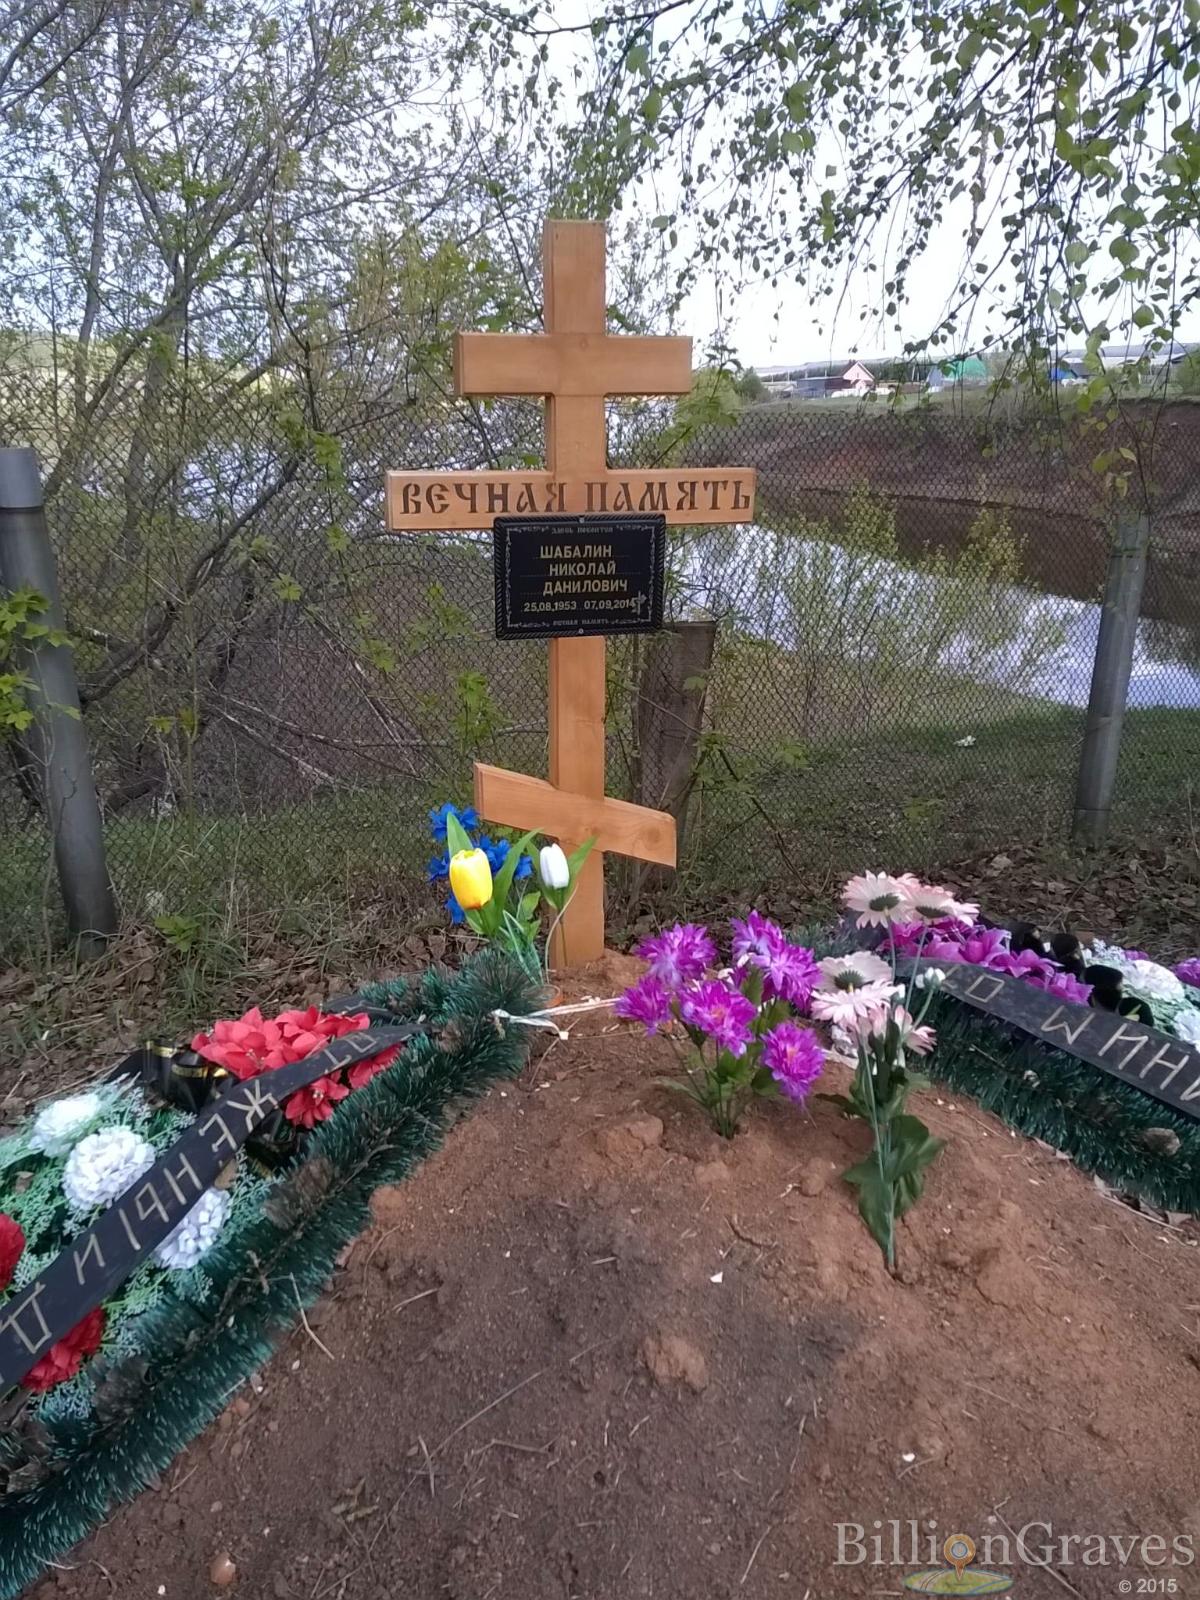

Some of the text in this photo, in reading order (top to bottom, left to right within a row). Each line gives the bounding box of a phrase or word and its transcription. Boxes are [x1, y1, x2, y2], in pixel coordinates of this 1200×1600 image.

[401, 480, 751, 514] ВЕЧНАЯ ПАМЯТЬ
[540, 545, 612, 559] ШАБАЛИН
[549, 560, 616, 576] НИКОЛАЙ
[543, 579, 628, 596] ДАНИЛОВИЧ
[523, 600, 577, 613] 25.08.1953
[74, 1234, 105, 1284] И
